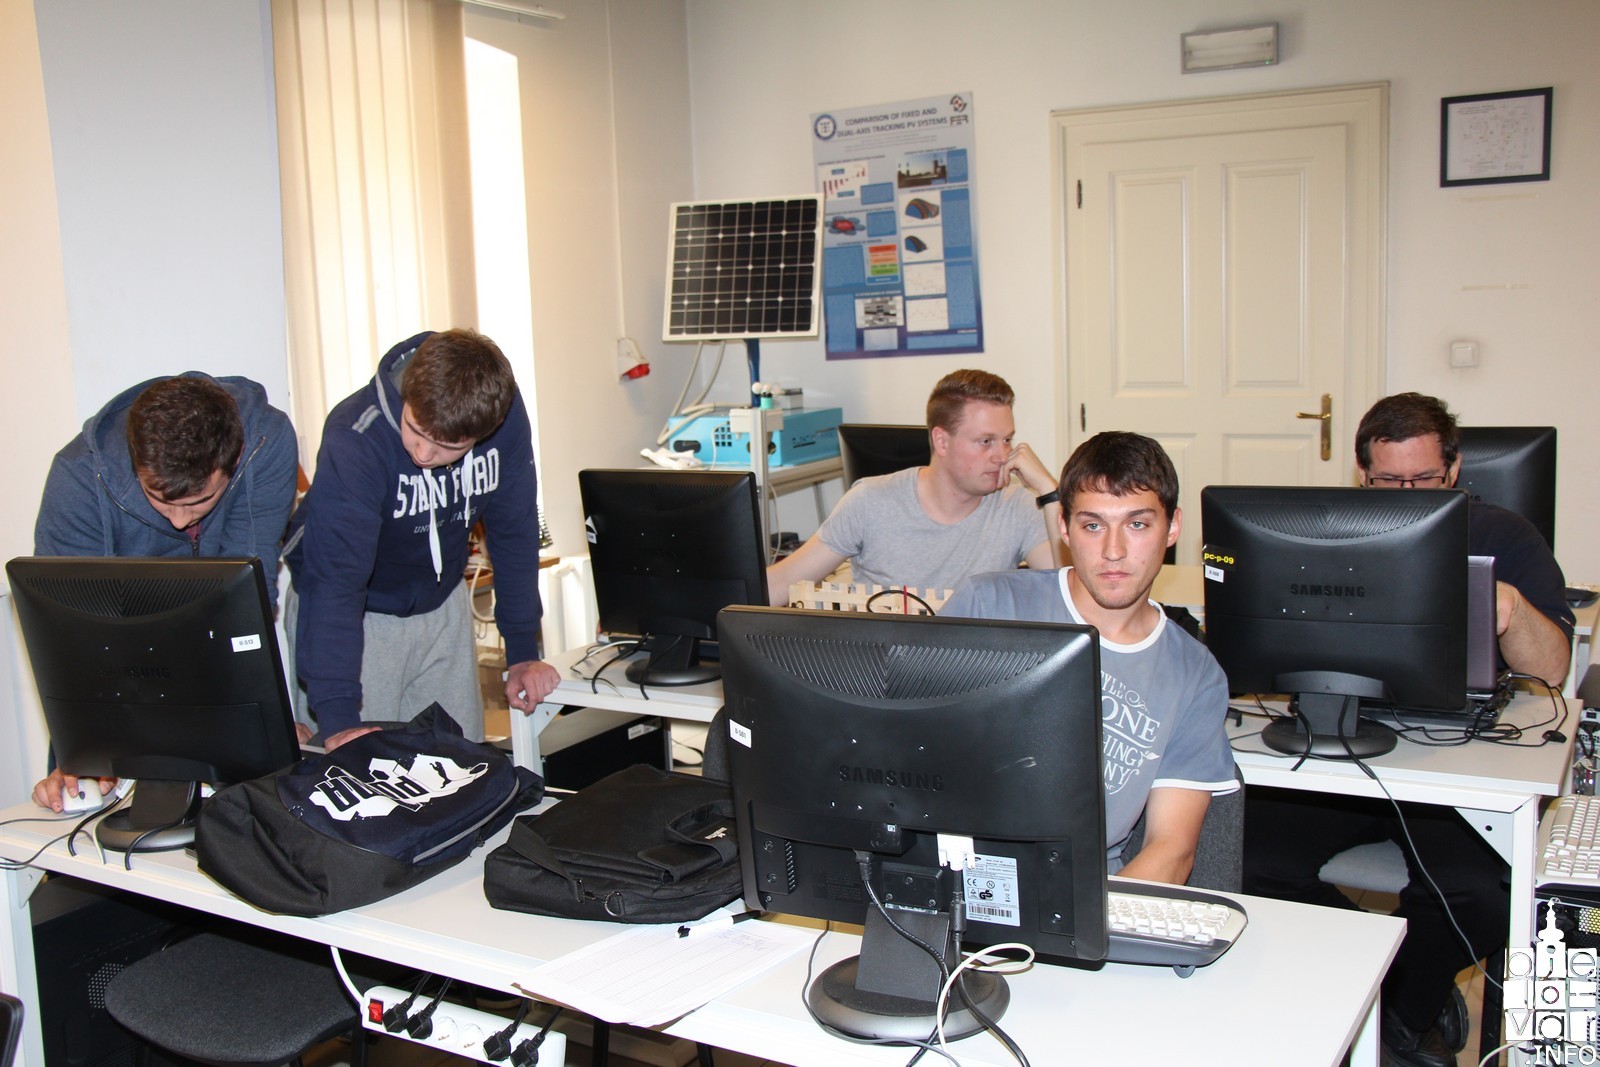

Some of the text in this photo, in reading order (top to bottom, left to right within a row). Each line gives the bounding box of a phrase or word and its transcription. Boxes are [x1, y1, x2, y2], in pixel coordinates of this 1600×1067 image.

[837, 125, 871, 138] DUAL-AXIS
[872, 121, 906, 134] TRACKING
[906, 119, 916, 129] PV
[917, 116, 948, 128] SYSTEMS
[845, 112, 890, 127] COMPARISON
[890, 112, 899, 121] OF
[901, 109, 920, 119] FIXED
[922, 107, 937, 116] AND
[1203, 552, 1235, 565] pc-p-09
[1290, 583, 1365, 598] SAMSUNG
[839, 764, 944, 792] SAMSUNG
